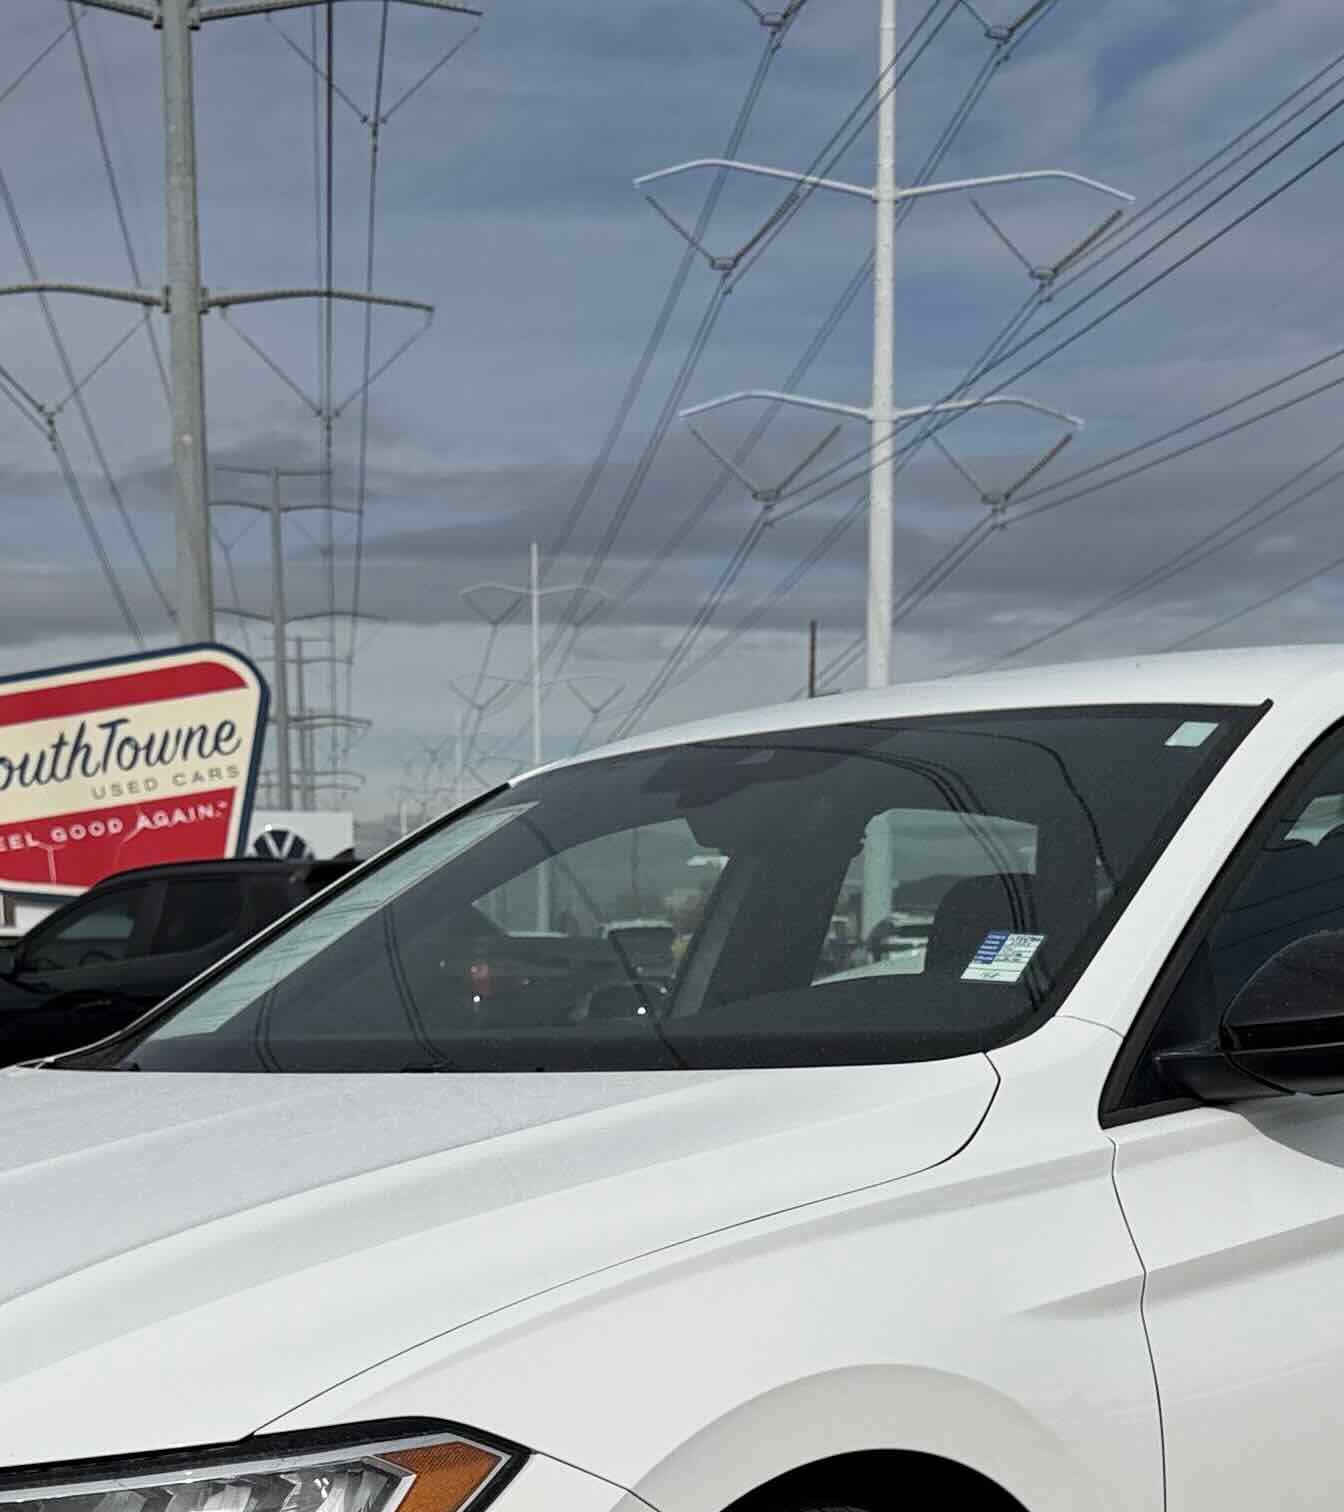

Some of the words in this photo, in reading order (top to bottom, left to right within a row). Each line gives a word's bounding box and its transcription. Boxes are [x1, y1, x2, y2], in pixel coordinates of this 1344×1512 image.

[90, 776, 159, 801] USED
[171, 765, 241, 788] CARS
[49, 816, 125, 843] GOOD
